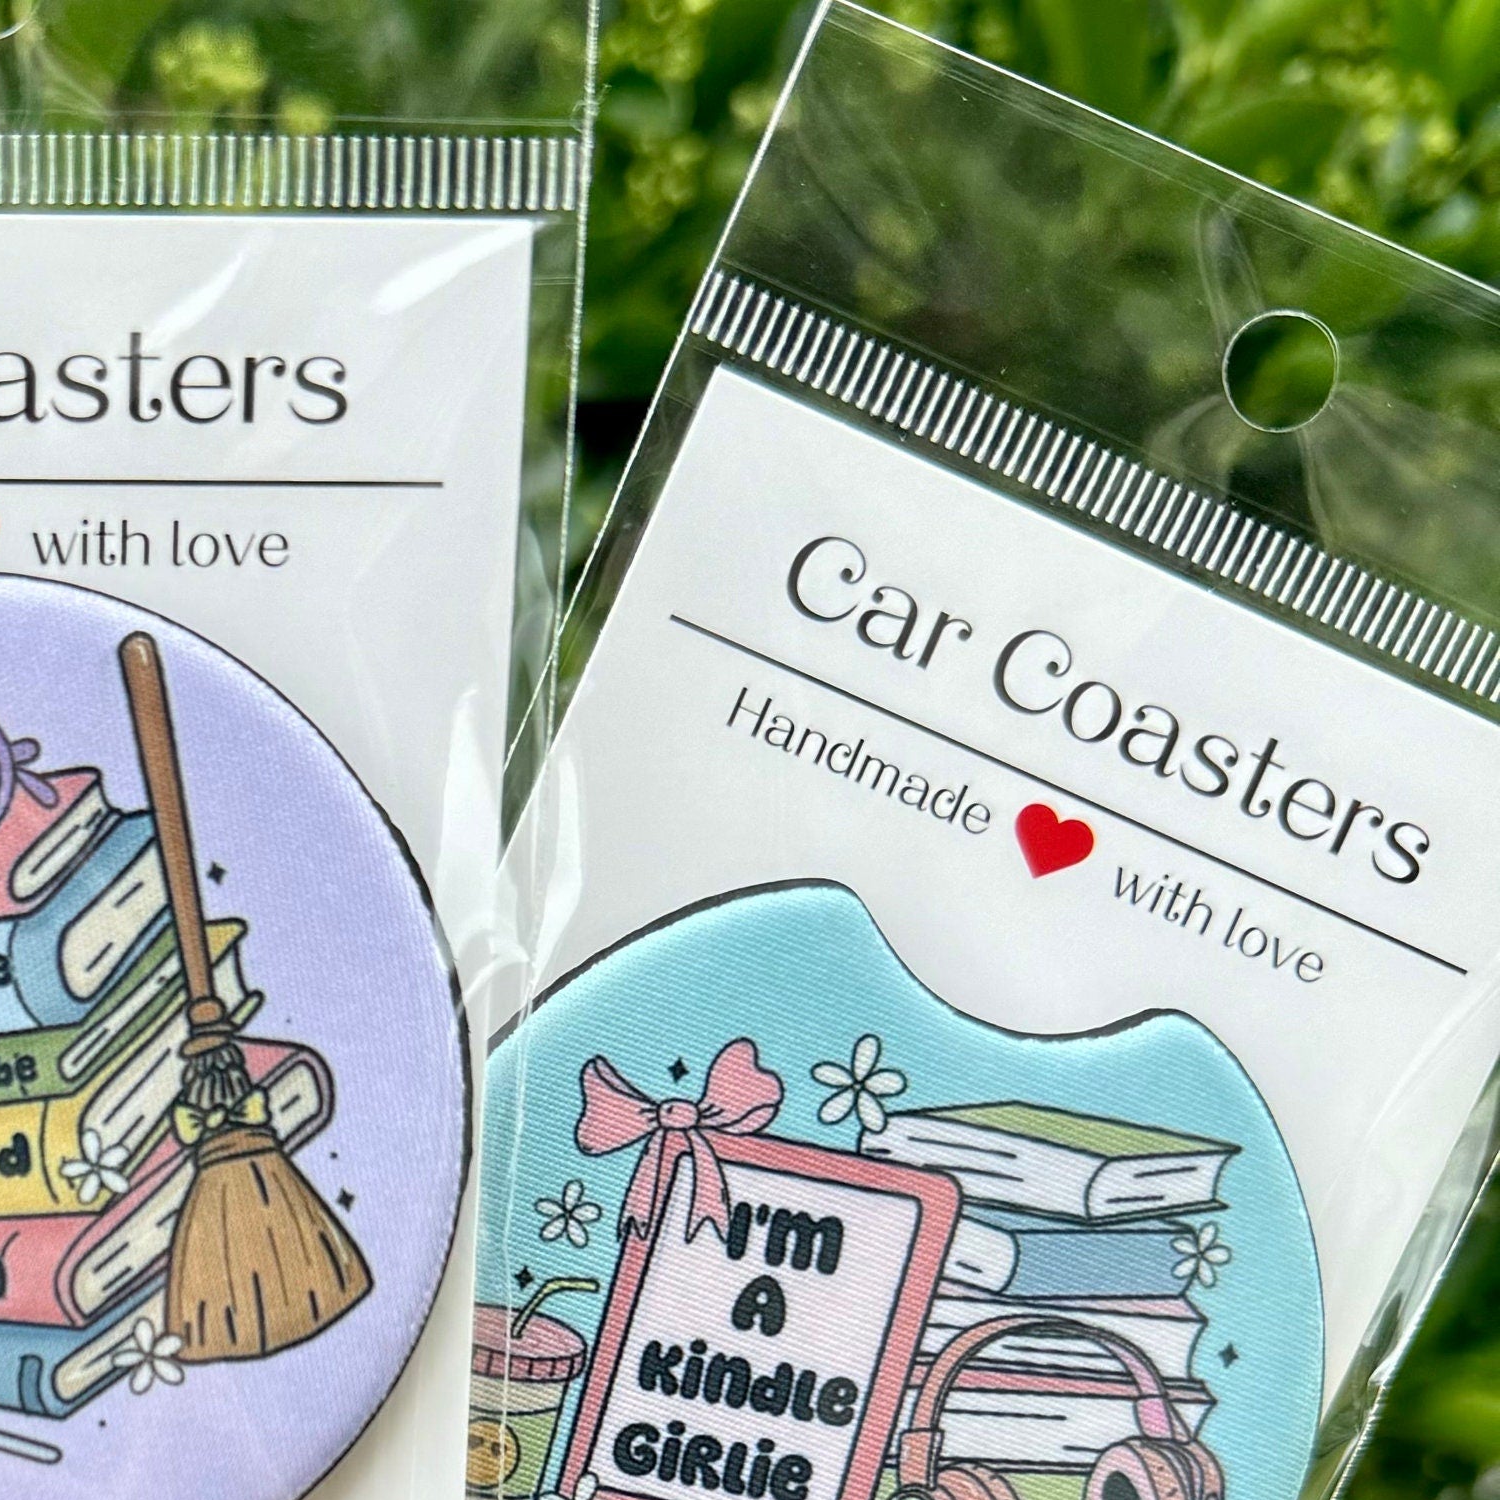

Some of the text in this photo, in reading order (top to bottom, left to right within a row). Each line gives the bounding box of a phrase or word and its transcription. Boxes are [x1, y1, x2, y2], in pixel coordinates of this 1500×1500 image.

[31, 518, 152, 568] with
[171, 519, 289, 570] love
[786, 535, 1431, 886] Car Coasters
[725, 686, 1325, 983] Handmade with love
[727, 1201, 845, 1276] I'm
[731, 1275, 786, 1338] A
[638, 1339, 860, 1427] Kindle
